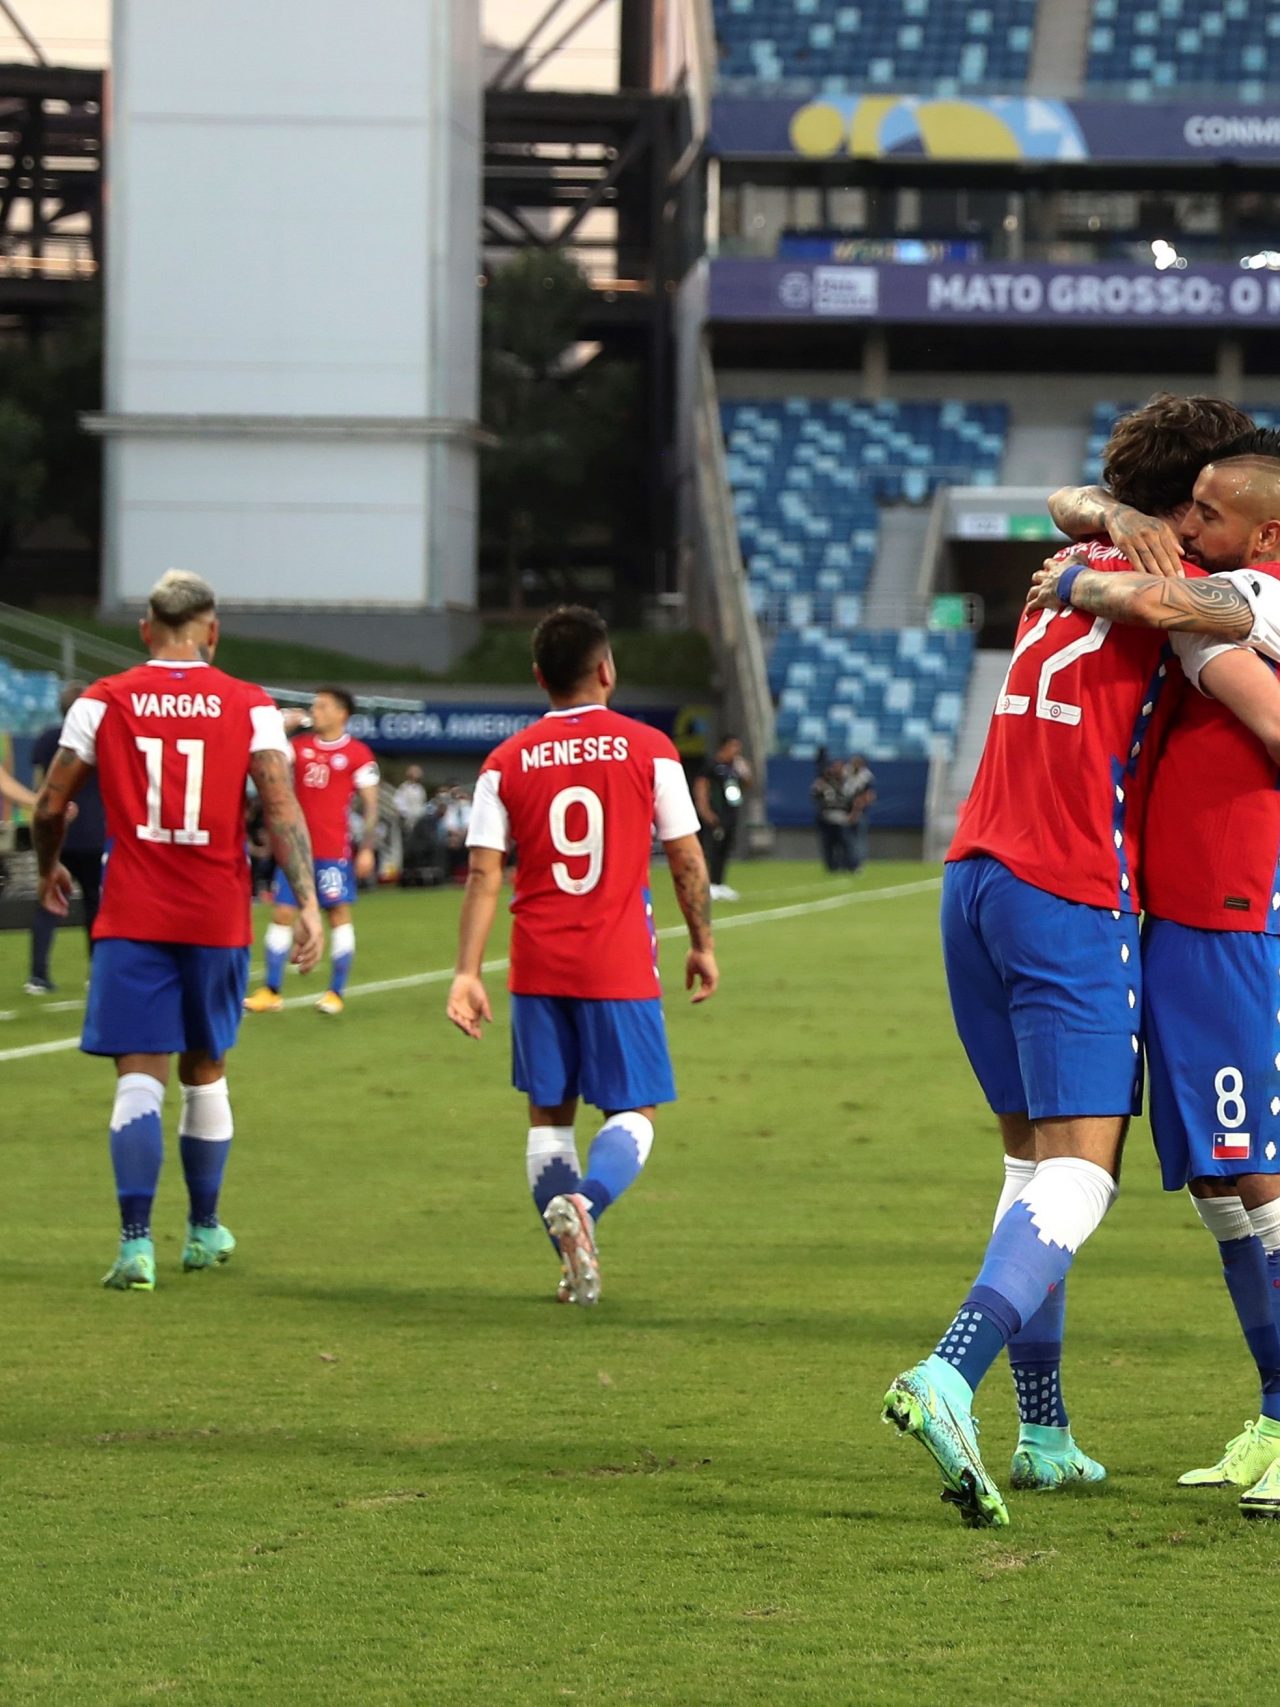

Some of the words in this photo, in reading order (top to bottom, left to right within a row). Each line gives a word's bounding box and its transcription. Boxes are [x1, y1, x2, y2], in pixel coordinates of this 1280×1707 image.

[928, 274, 1041, 313] MATO
[1048, 276, 1223, 315] GROSSO:
[1230, 277, 1263, 315] O
[131, 692, 222, 718] VARGAS
[380, 712, 442, 740] COPA
[521, 735, 629, 773] MENESES
[135, 736, 210, 845] 11
[549, 786, 605, 896] 9
[1214, 1066, 1246, 1128] 8
